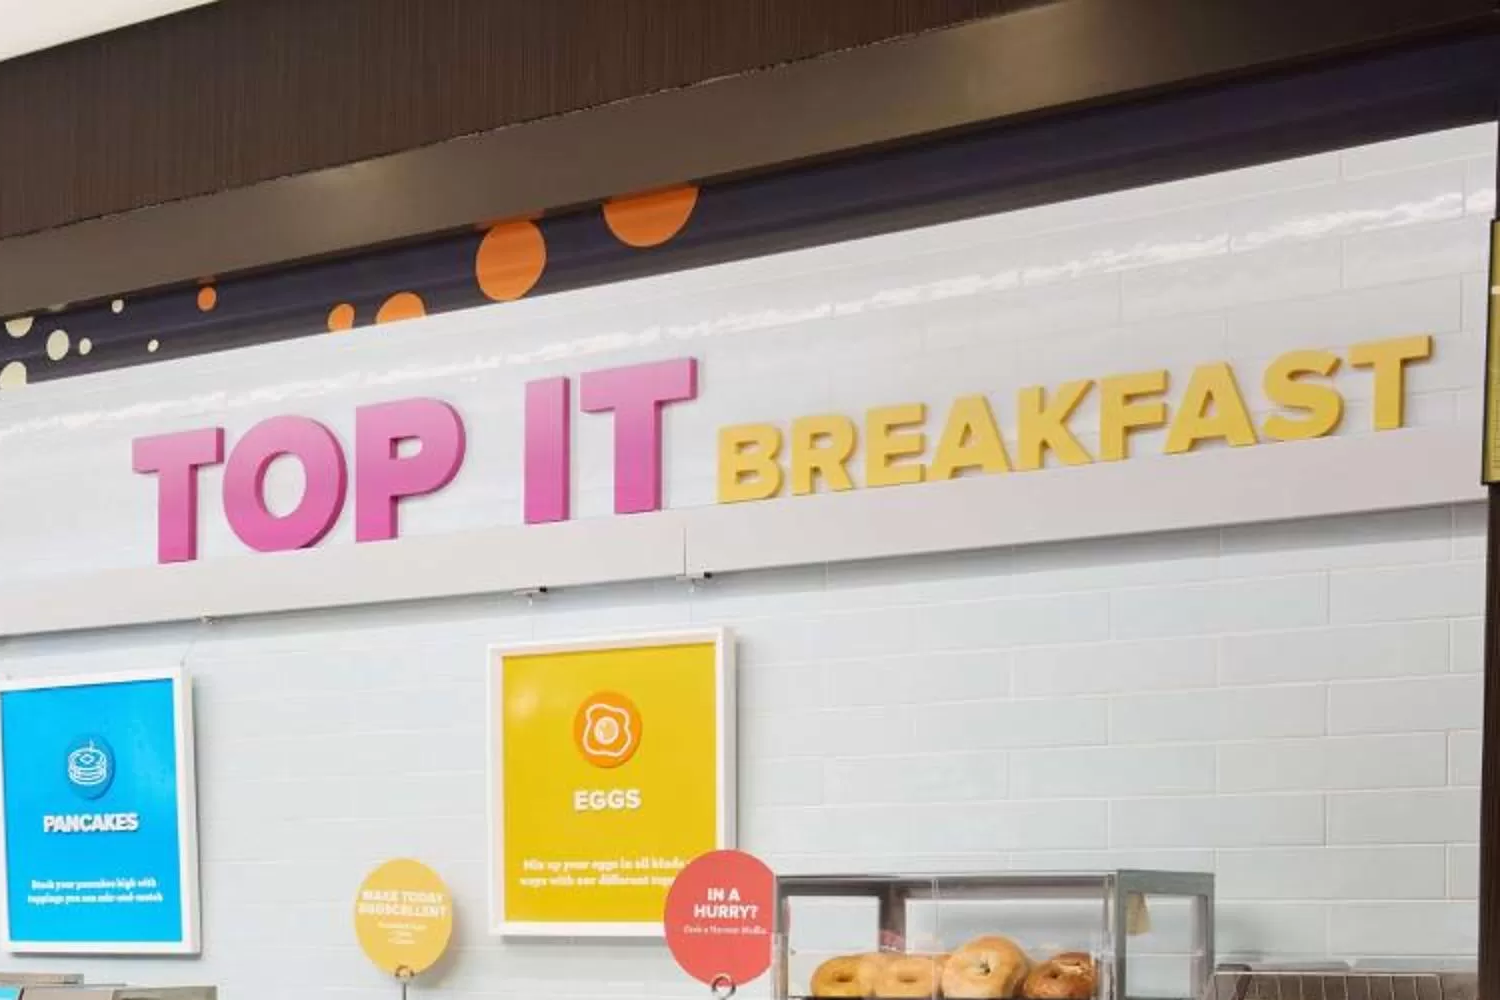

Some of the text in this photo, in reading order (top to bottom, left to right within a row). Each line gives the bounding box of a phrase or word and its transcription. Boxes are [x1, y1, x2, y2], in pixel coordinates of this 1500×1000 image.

[133, 335, 1432, 564] TOP IT BREAKFAST
[573, 789, 642, 811] EGGS
[42, 812, 140, 832] PANCAKES
[707, 887, 741, 901] IN A
[693, 903, 760, 919] HURRY?
